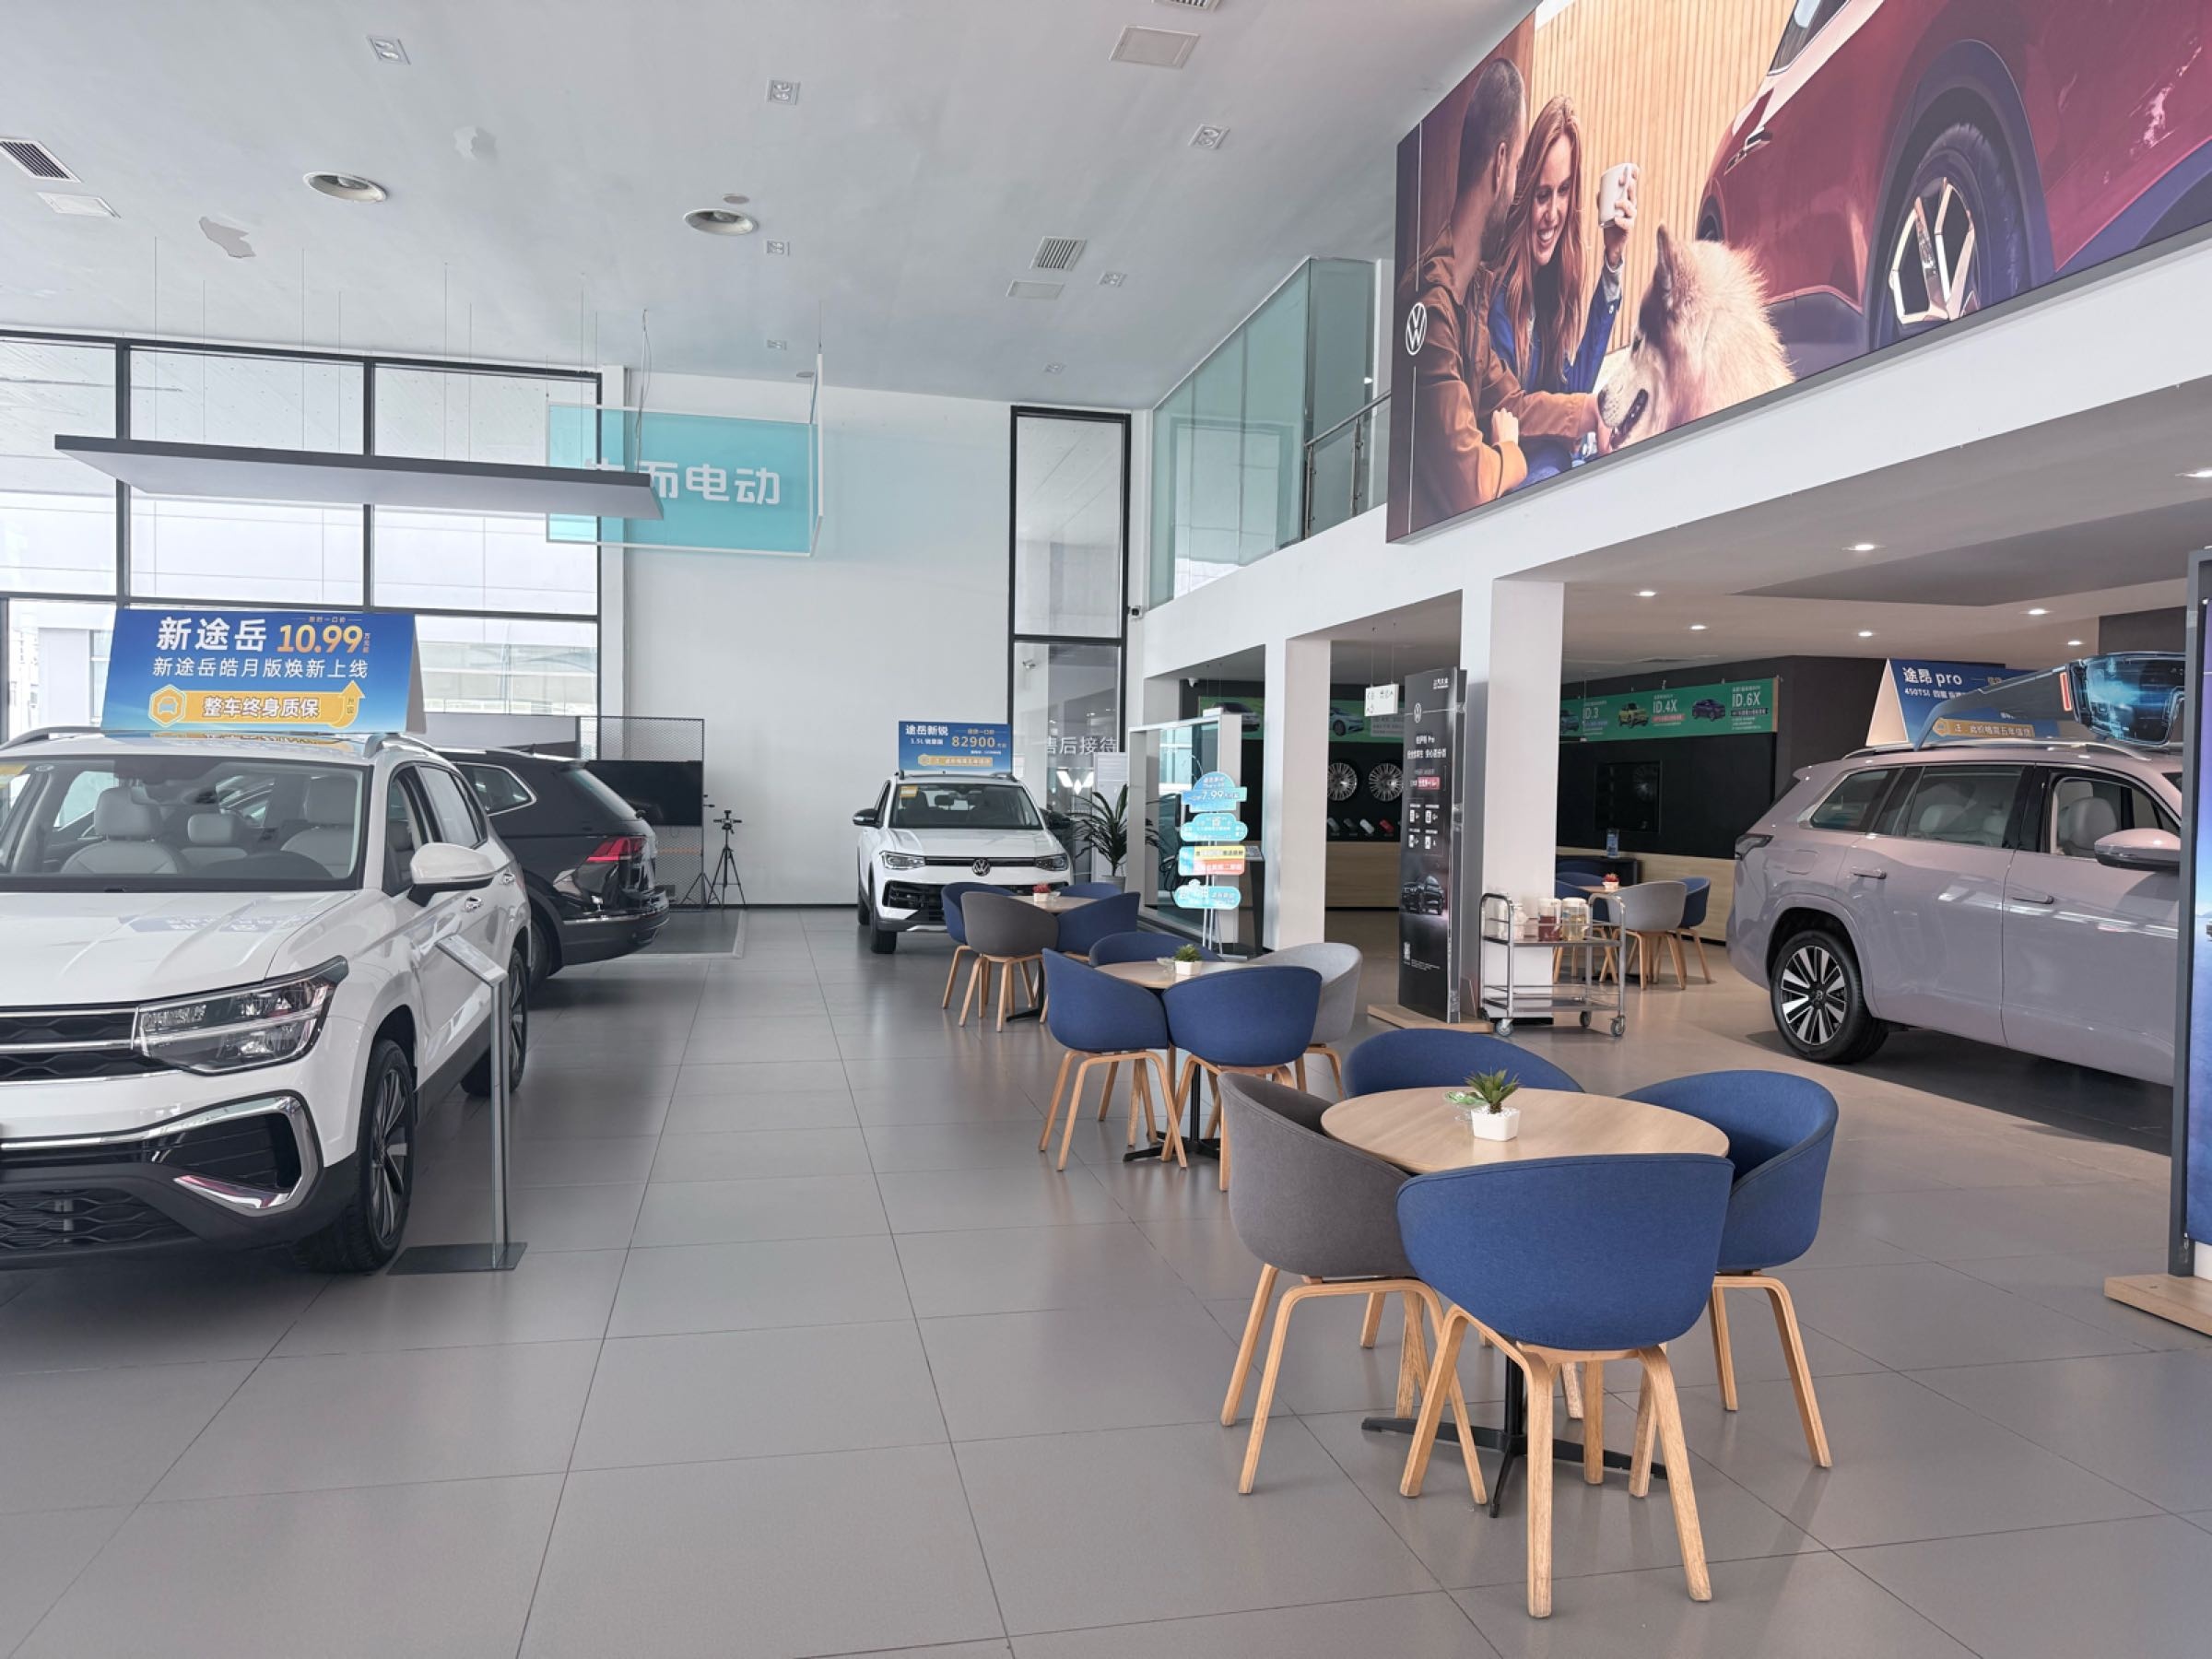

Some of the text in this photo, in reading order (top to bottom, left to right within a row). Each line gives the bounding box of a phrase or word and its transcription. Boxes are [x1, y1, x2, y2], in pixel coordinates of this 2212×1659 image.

[156, 616, 268, 653] 新途岳
[276, 624, 363, 653] 10.99
[152, 656, 369, 679] 新途岳皓月版焕新上线
[1901, 666, 1933, 685] 途昂
[1936, 672, 1963, 688] pro
[201, 696, 321, 719] 整车终身质保
[1653, 699, 1678, 714] ID.4X
[1731, 691, 1761, 709] ID.6X
[951, 736, 995, 747] 82900
